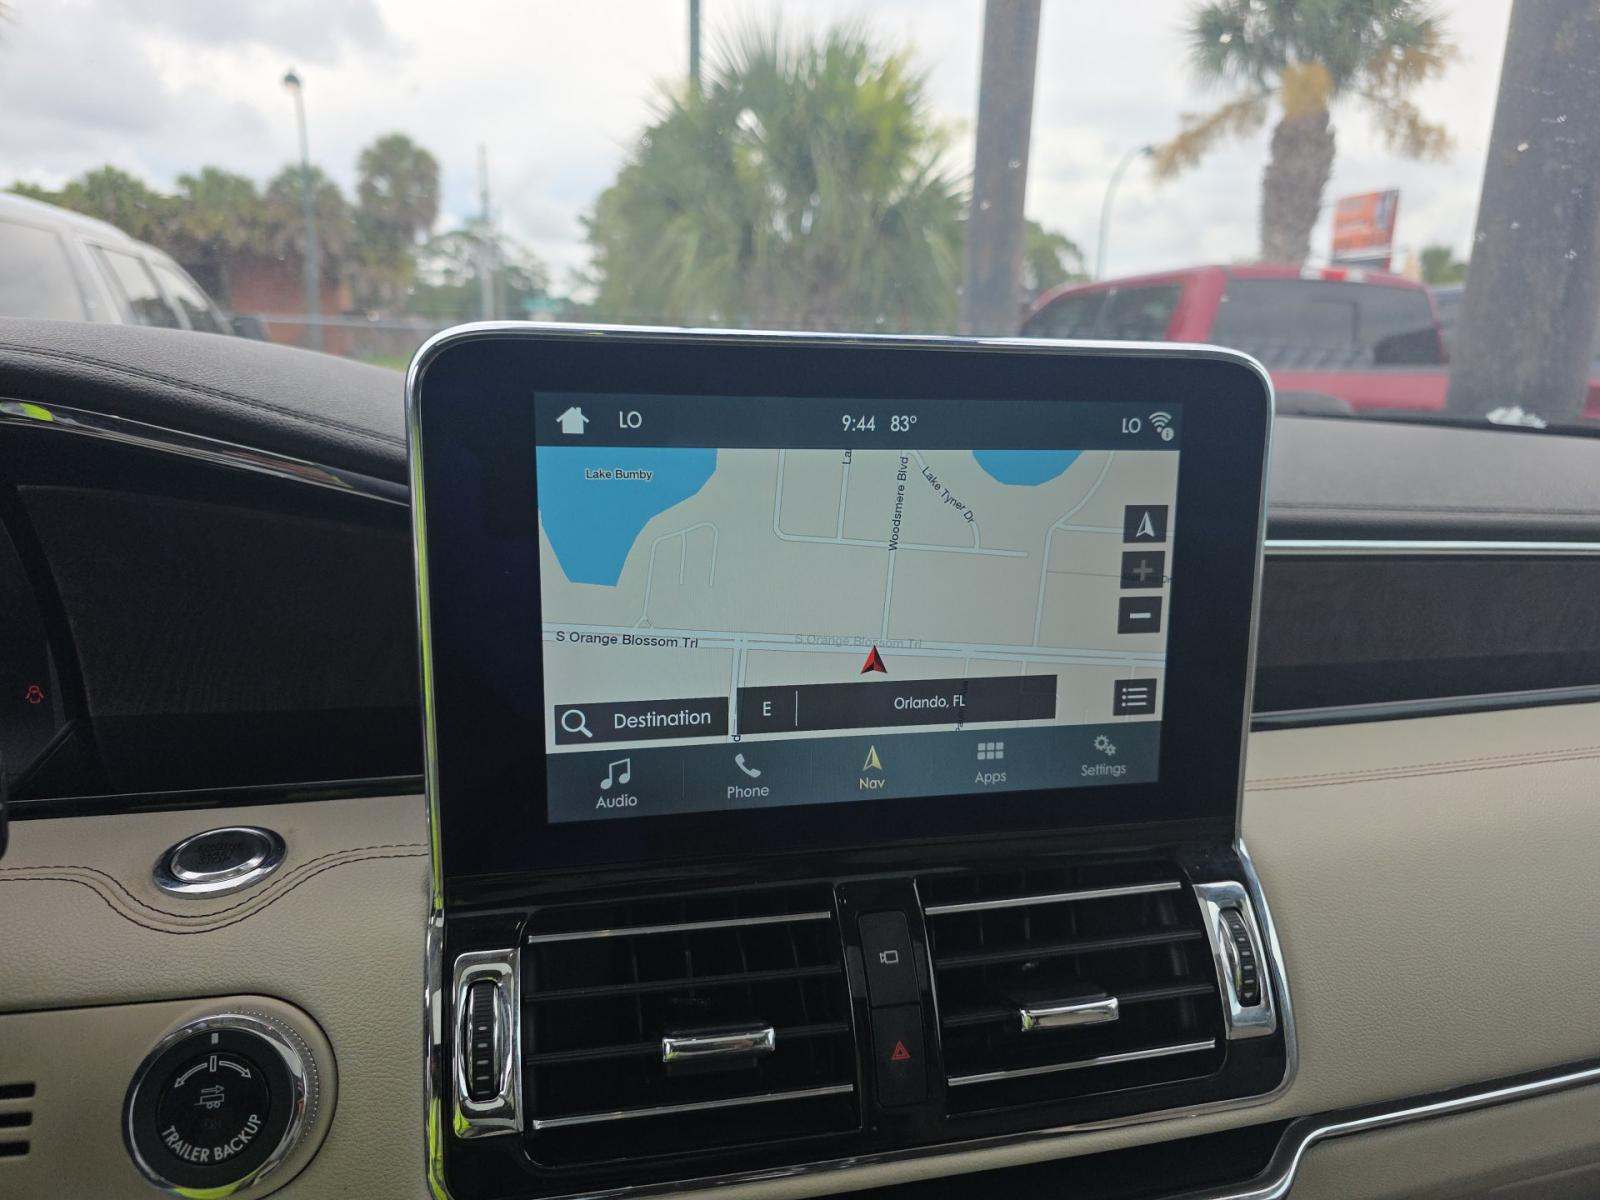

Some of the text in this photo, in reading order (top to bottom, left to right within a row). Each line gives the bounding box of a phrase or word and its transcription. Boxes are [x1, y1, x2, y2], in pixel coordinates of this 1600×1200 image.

[618, 411, 643, 429] LO
[842, 415, 917, 432] 9:44 83°
[1121, 417, 1141, 435] LO
[585, 468, 653, 482] Lake Bumby
[888, 456, 909, 551] Woodsmere Blvd
[921, 465, 976, 524] Lake Tyner Dr
[556, 630, 699, 649] S Orange Blossom Trl
[807, 634, 851, 648] Orange
[854, 634, 906, 649] Blossom
[763, 701, 772, 717] E
[893, 694, 966, 711] Orlando, FL
[613, 708, 712, 730] Destination
[974, 769, 1007, 788] Apps
[1080, 762, 1127, 781] Settings
[726, 785, 770, 799] Phone
[858, 777, 886, 791] Nav
[595, 794, 638, 809] Audio
[162, 1114, 261, 1162] TRAILER BACKUP
